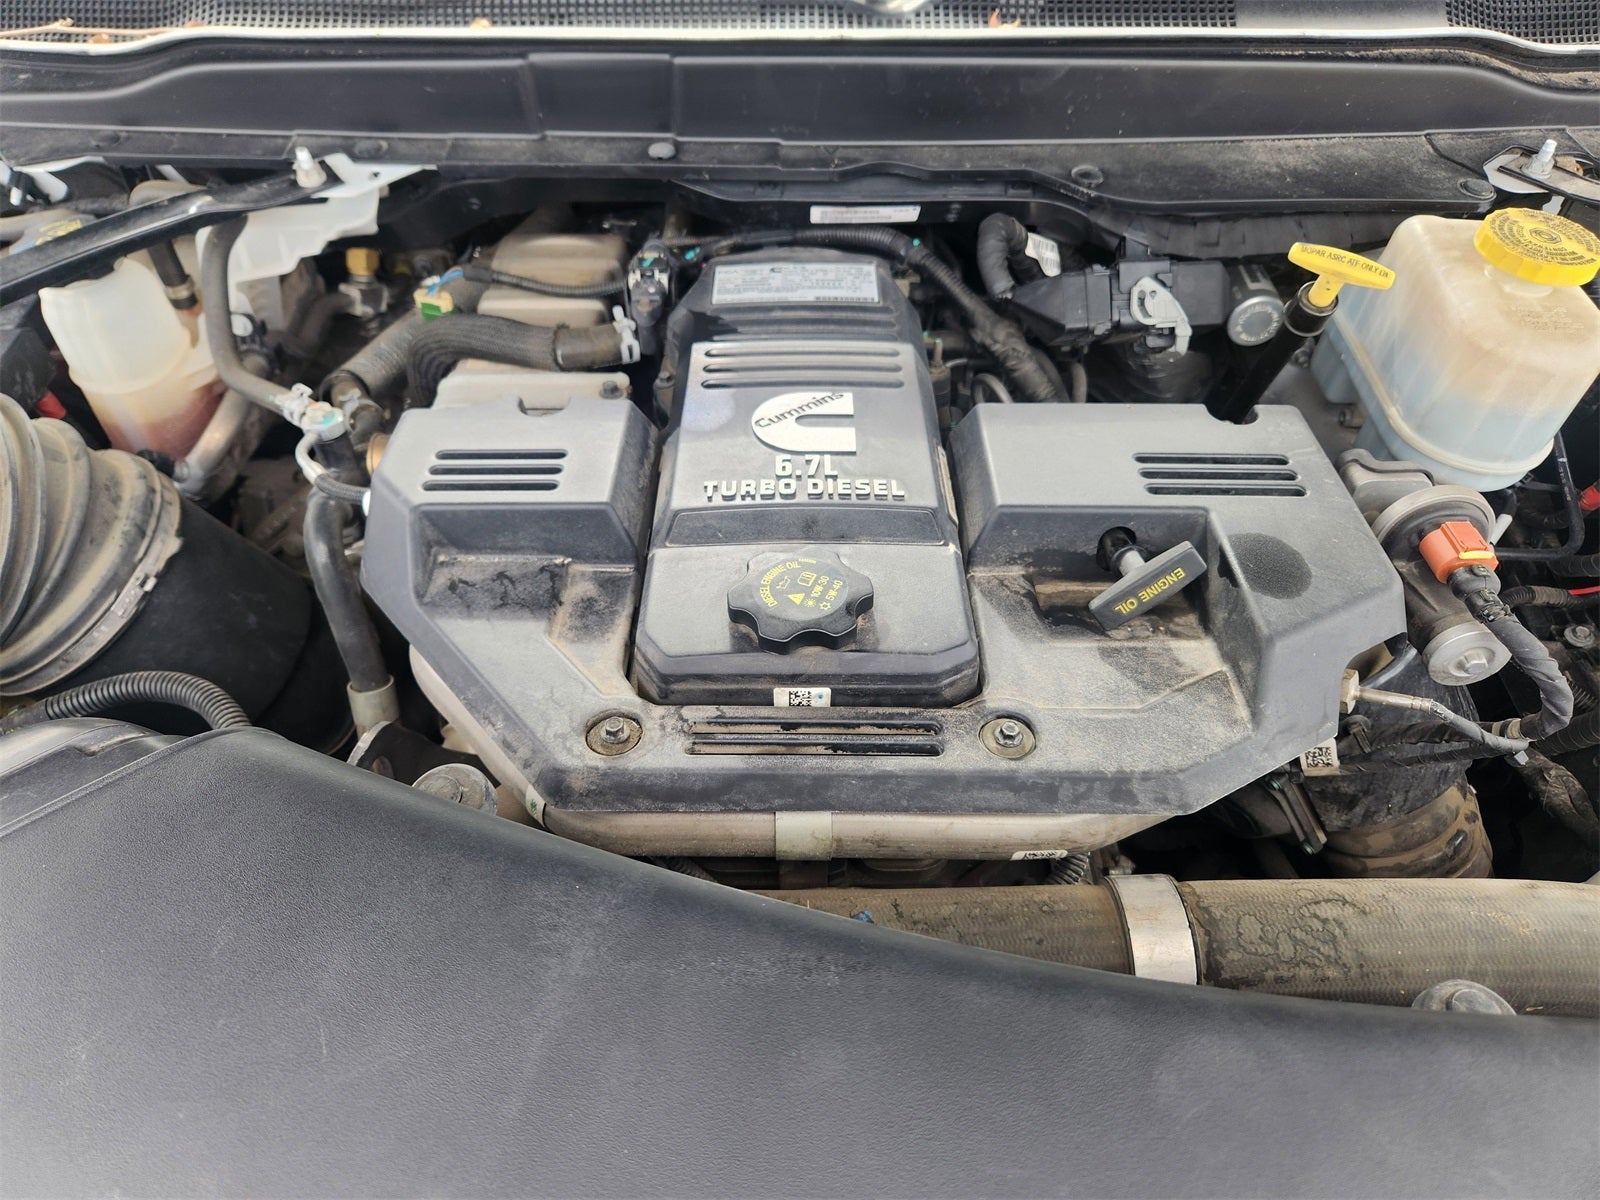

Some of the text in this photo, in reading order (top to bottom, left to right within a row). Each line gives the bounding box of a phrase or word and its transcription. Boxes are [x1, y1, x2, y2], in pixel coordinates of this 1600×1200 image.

[1301, 245, 1326, 256] MOPAR
[755, 391, 844, 428] Cummins
[775, 454, 838, 478] 6.7L
[704, 478, 905, 502] TURBO DIESEL
[760, 585, 778, 607] DIESEL
[785, 561, 801, 570] OIL
[1114, 567, 1186, 615] ENGINE OIL
